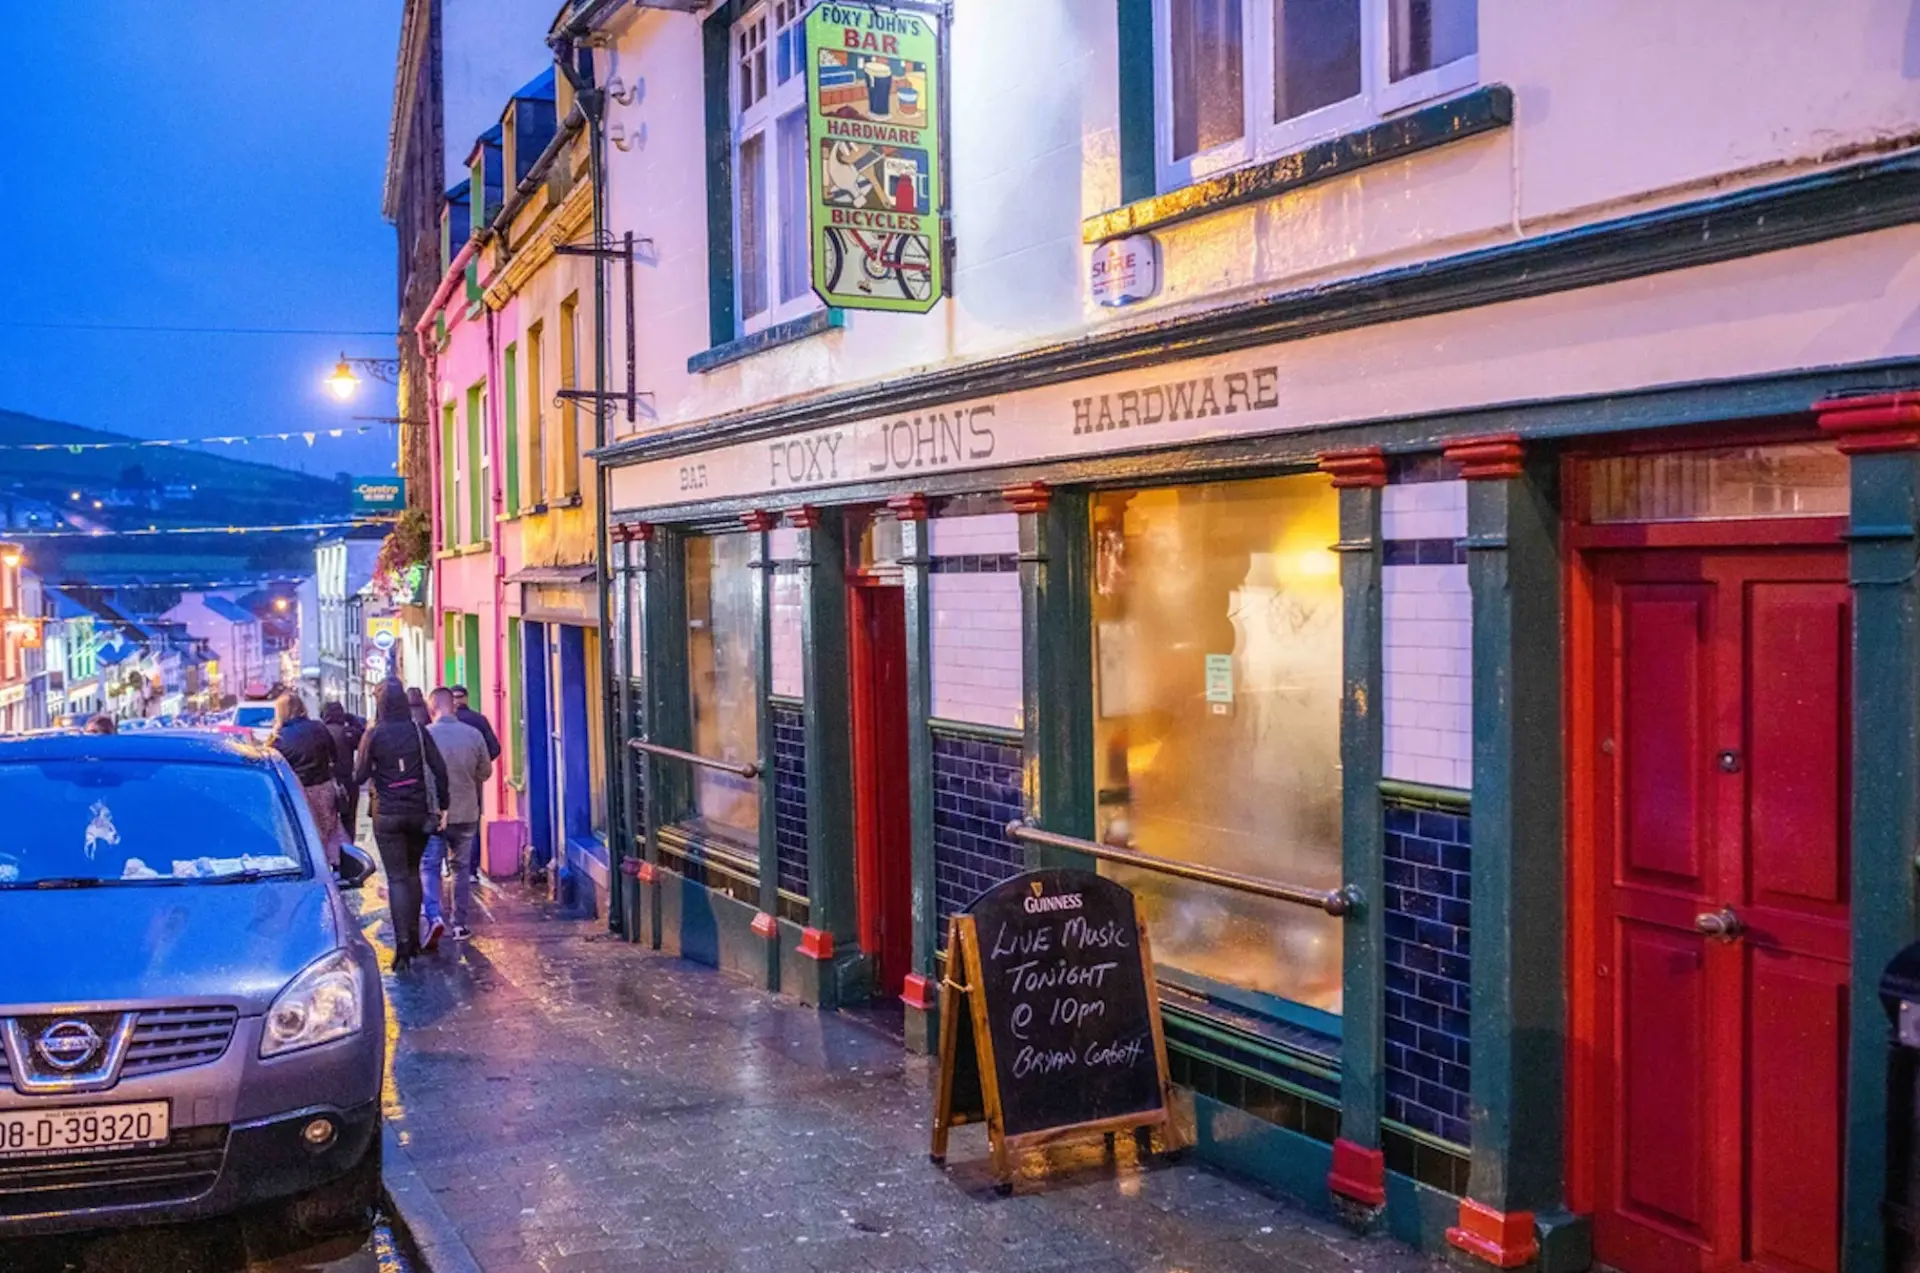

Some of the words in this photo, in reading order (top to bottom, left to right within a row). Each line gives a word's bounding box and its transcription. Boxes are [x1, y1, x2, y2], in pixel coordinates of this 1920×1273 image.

[821, 6, 862, 27] FOXY
[866, 14, 920, 36] JOHN'S
[844, 27, 898, 54] BAR
[827, 120, 919, 144] HARDWARE
[831, 209, 920, 231] BICYCLES
[679, 463, 708, 491] BAR
[768, 431, 843, 486] FOXY
[869, 405, 996, 473] JOHN'S
[1072, 366, 1279, 435] HARDWARE
[1023, 893, 1083, 914] GUINNESS
[990, 921, 1052, 960] LIVE
[1011, 1003, 1033, 1039] @
